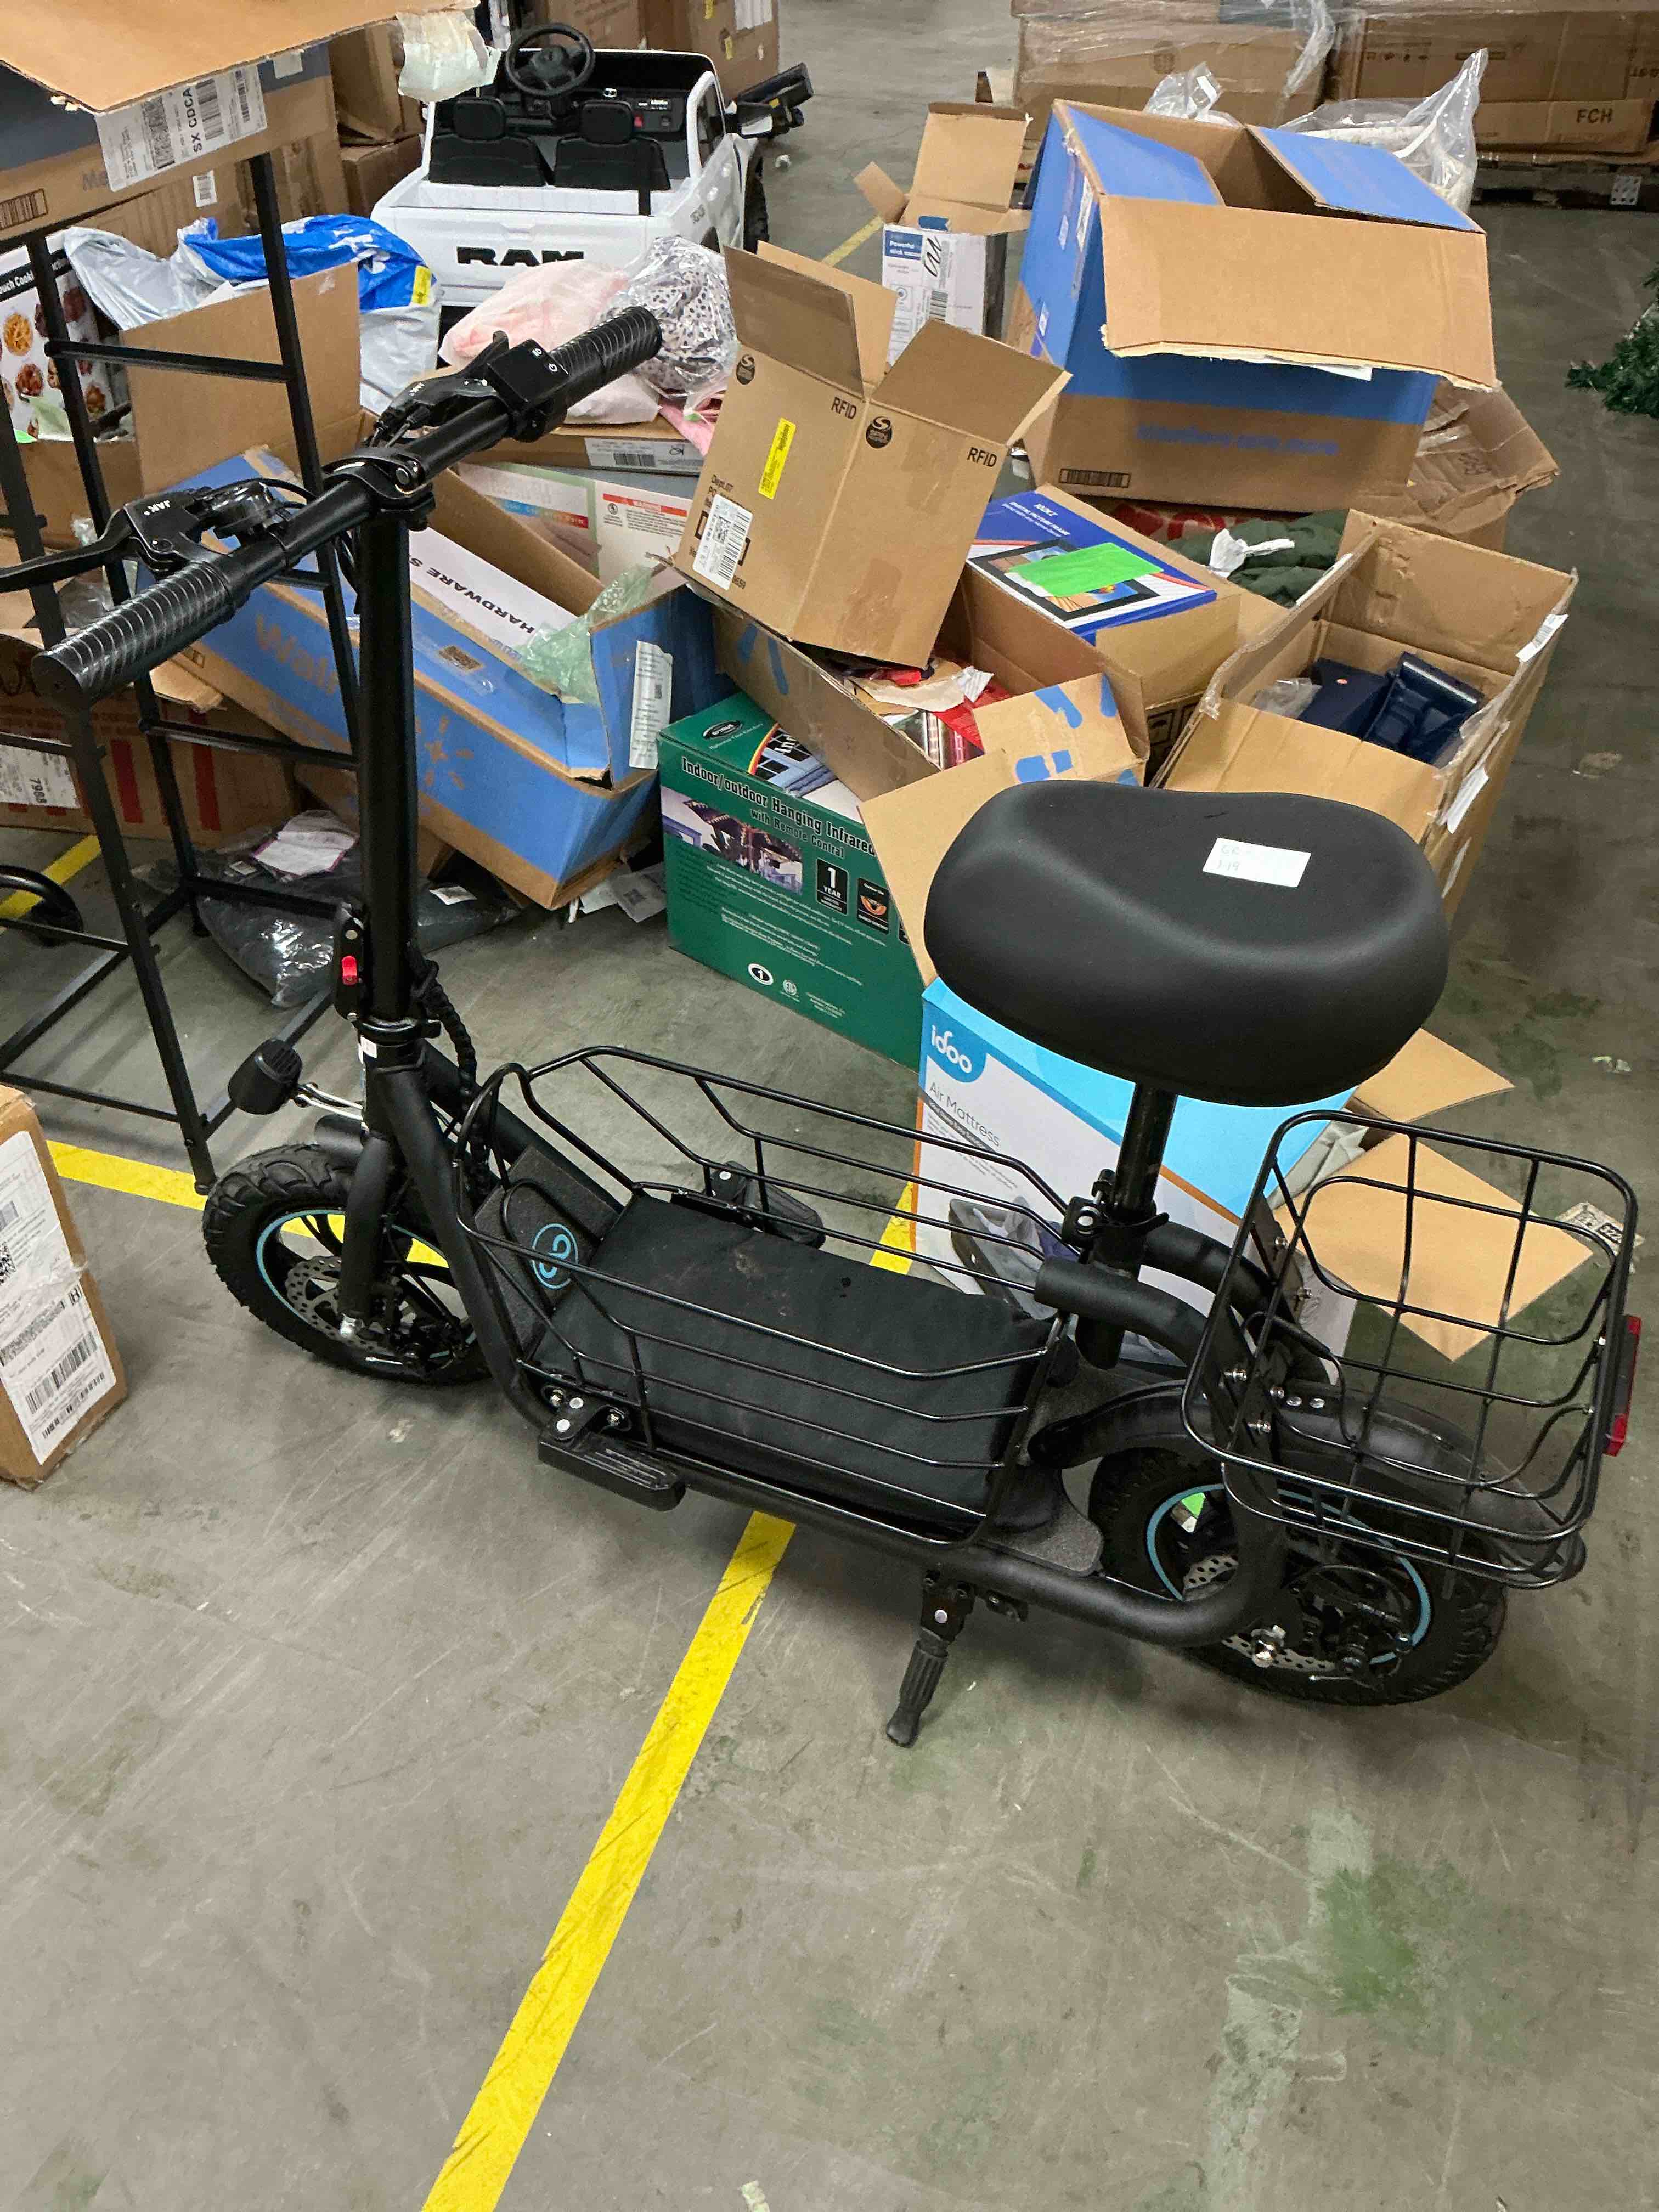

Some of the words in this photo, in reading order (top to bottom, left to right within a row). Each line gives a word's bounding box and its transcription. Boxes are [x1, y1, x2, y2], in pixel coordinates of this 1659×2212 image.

[1577, 108, 1613, 123] FCH
[831, 397, 856, 420] RFID
[967, 447, 997, 467] RFID
[426, 567, 535, 634] HARDWARE
[682, 756, 768, 809] Indoor/outdoor
[771, 796, 822, 836] Hanging
[750, 808, 771, 825] with
[774, 817, 808, 842] Remote
[811, 831, 844, 859] Control
[823, 885, 842, 899] YEAR
[827, 867, 836, 888] 1
[931, 1024, 972, 1074] idoo
[929, 1082, 944, 1102] Air
[946, 1096, 1000, 1147] Mattress
